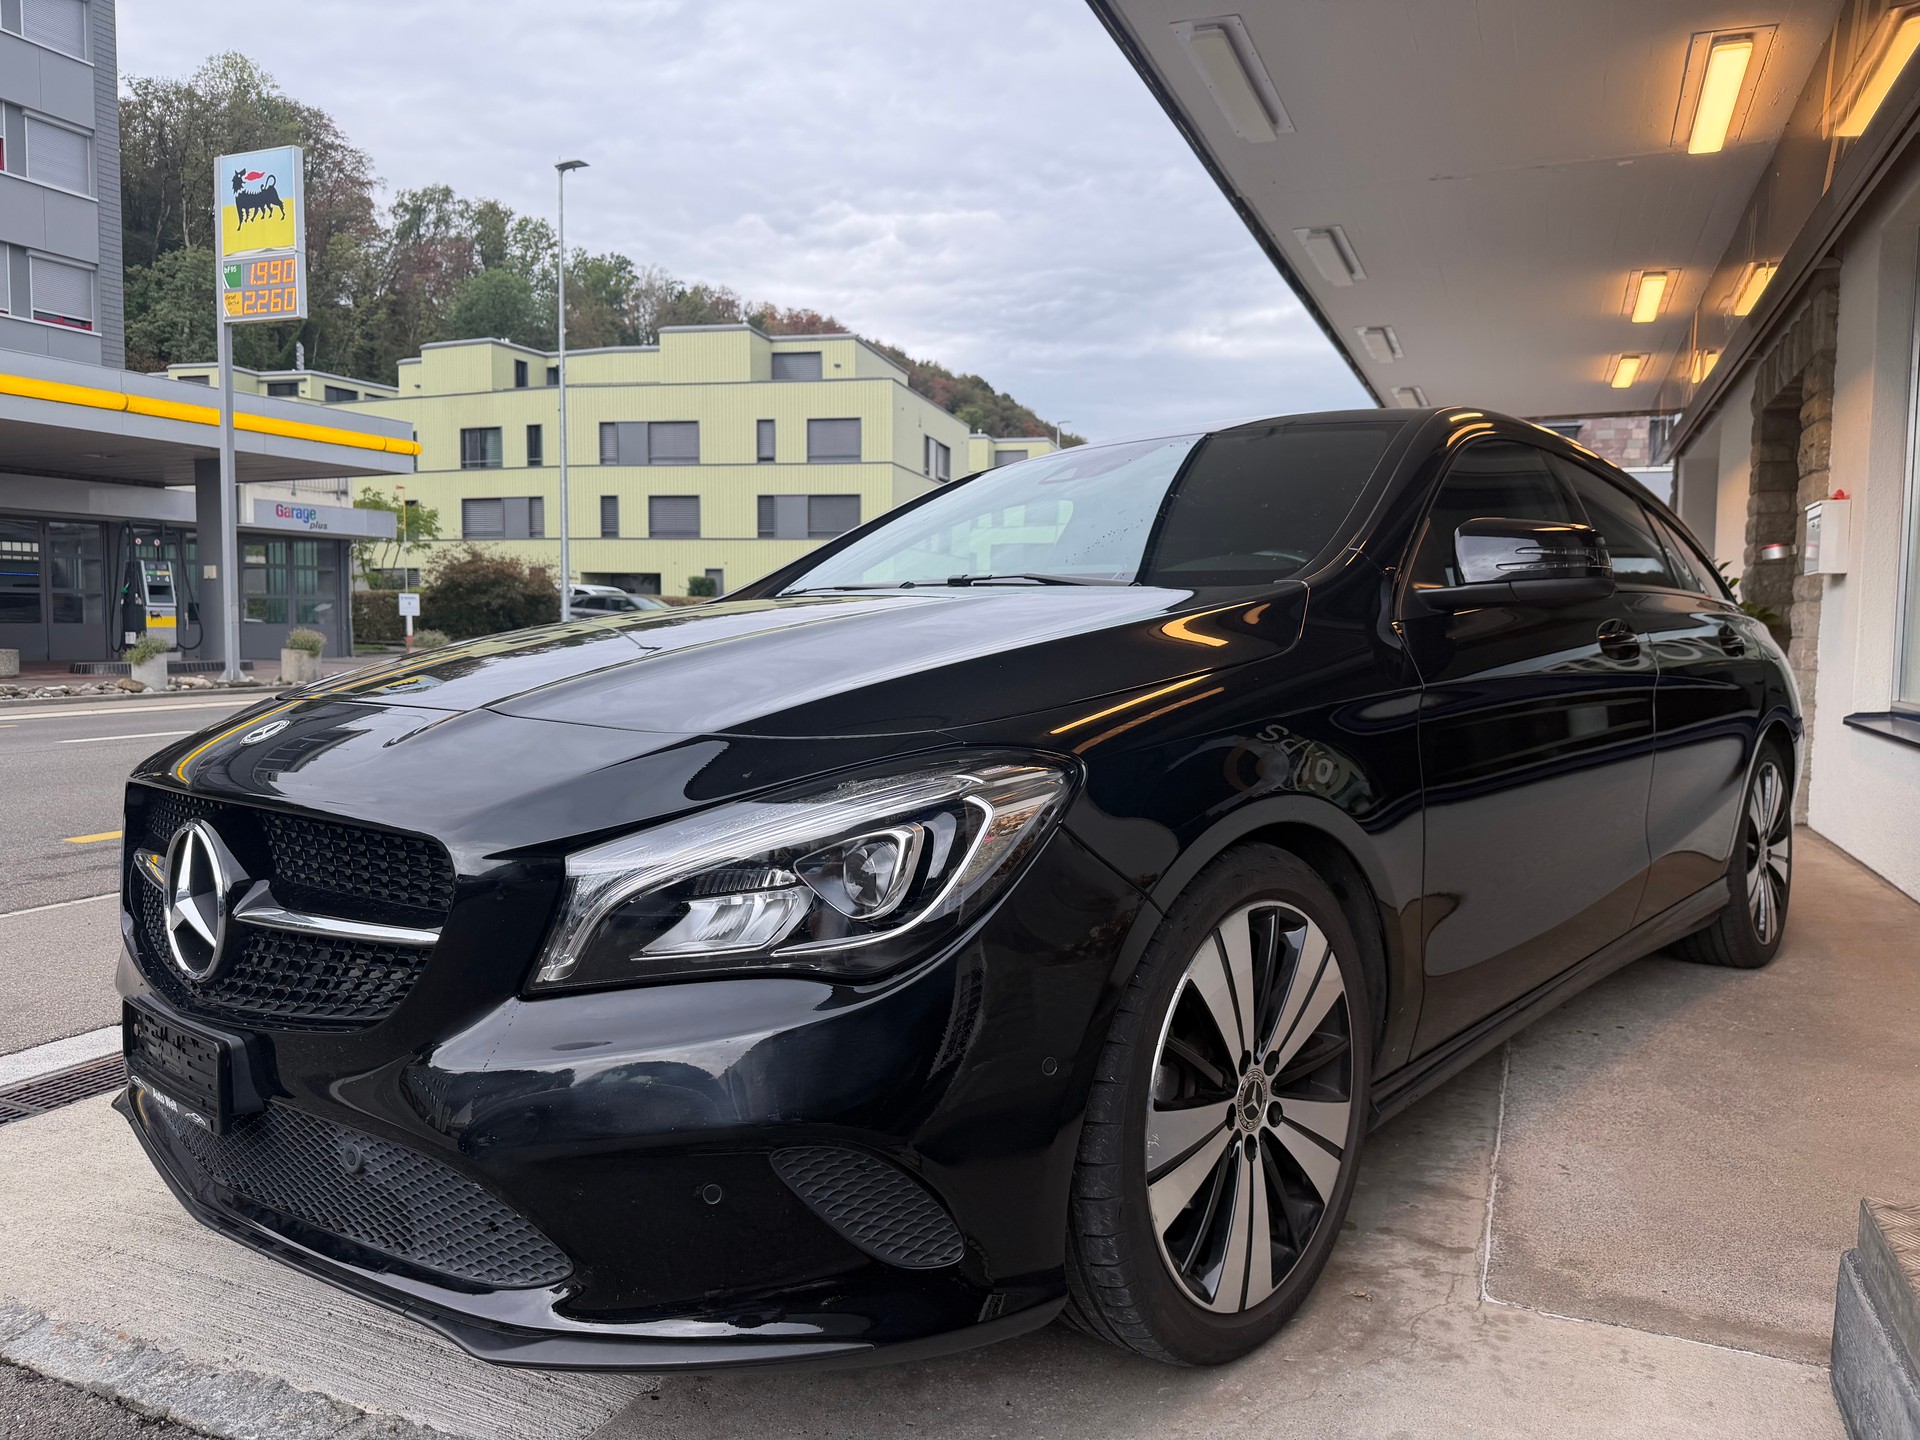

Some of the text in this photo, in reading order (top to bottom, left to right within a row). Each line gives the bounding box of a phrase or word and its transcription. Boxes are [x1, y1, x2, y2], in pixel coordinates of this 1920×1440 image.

[243, 287, 296, 314] 2.260
[275, 503, 317, 524] Garage
[309, 520, 328, 530] plus
